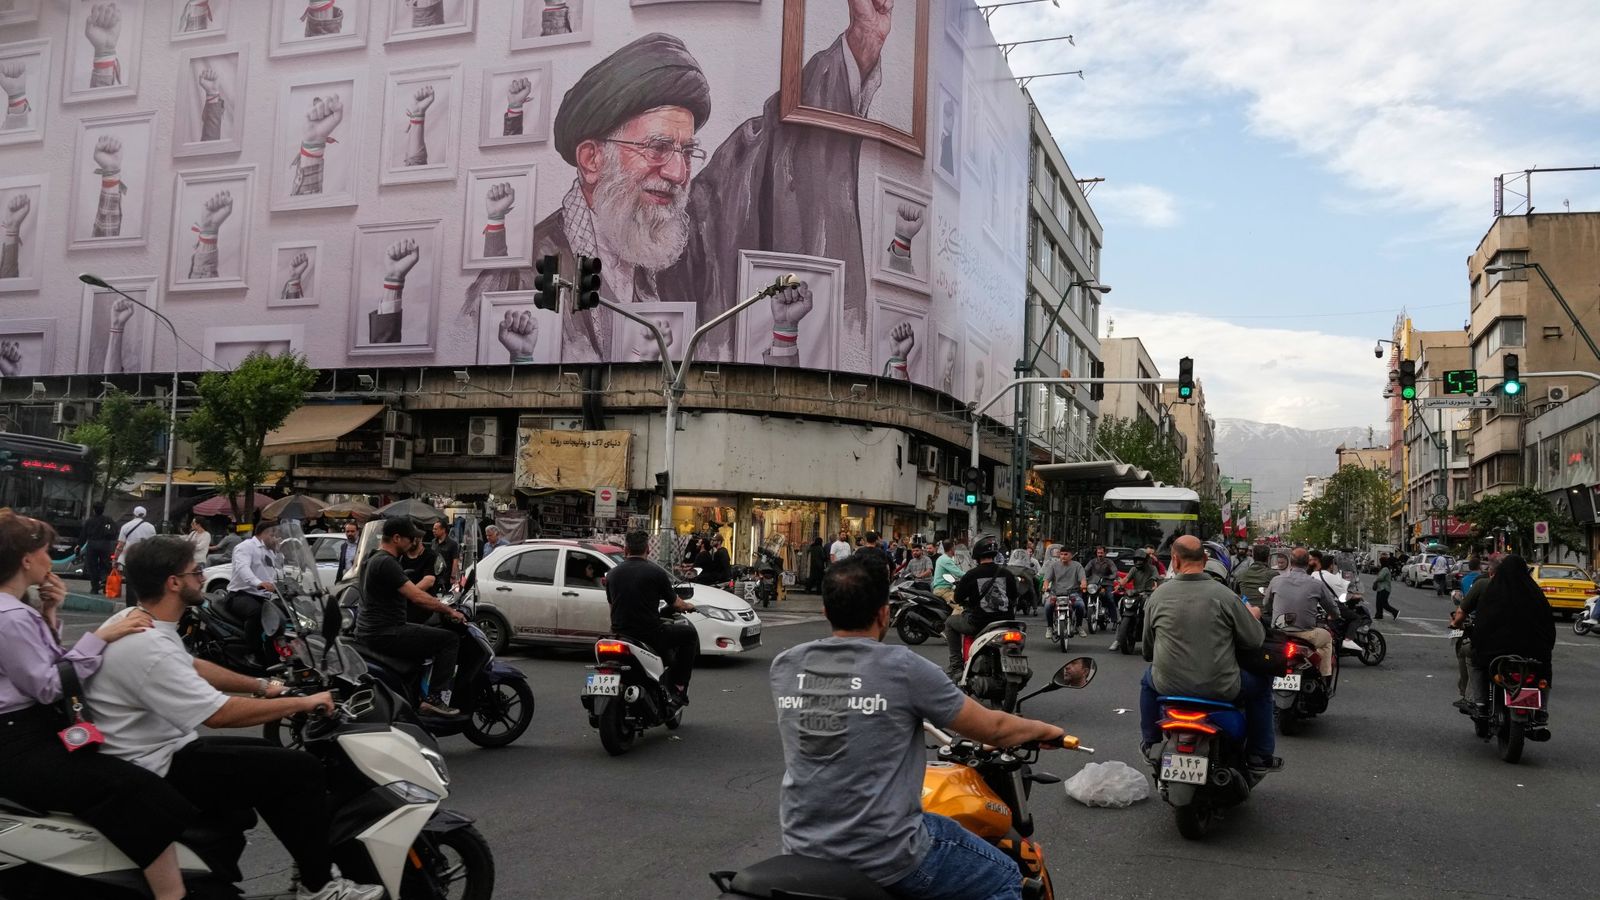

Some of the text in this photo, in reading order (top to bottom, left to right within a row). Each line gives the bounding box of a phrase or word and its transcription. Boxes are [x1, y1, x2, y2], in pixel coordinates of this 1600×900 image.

[603, 439, 621, 449] دنیای
[1179, 757, 1201, 769] ۱۴۴
[1164, 768, 1204, 782] ۵۶۵۷۳
